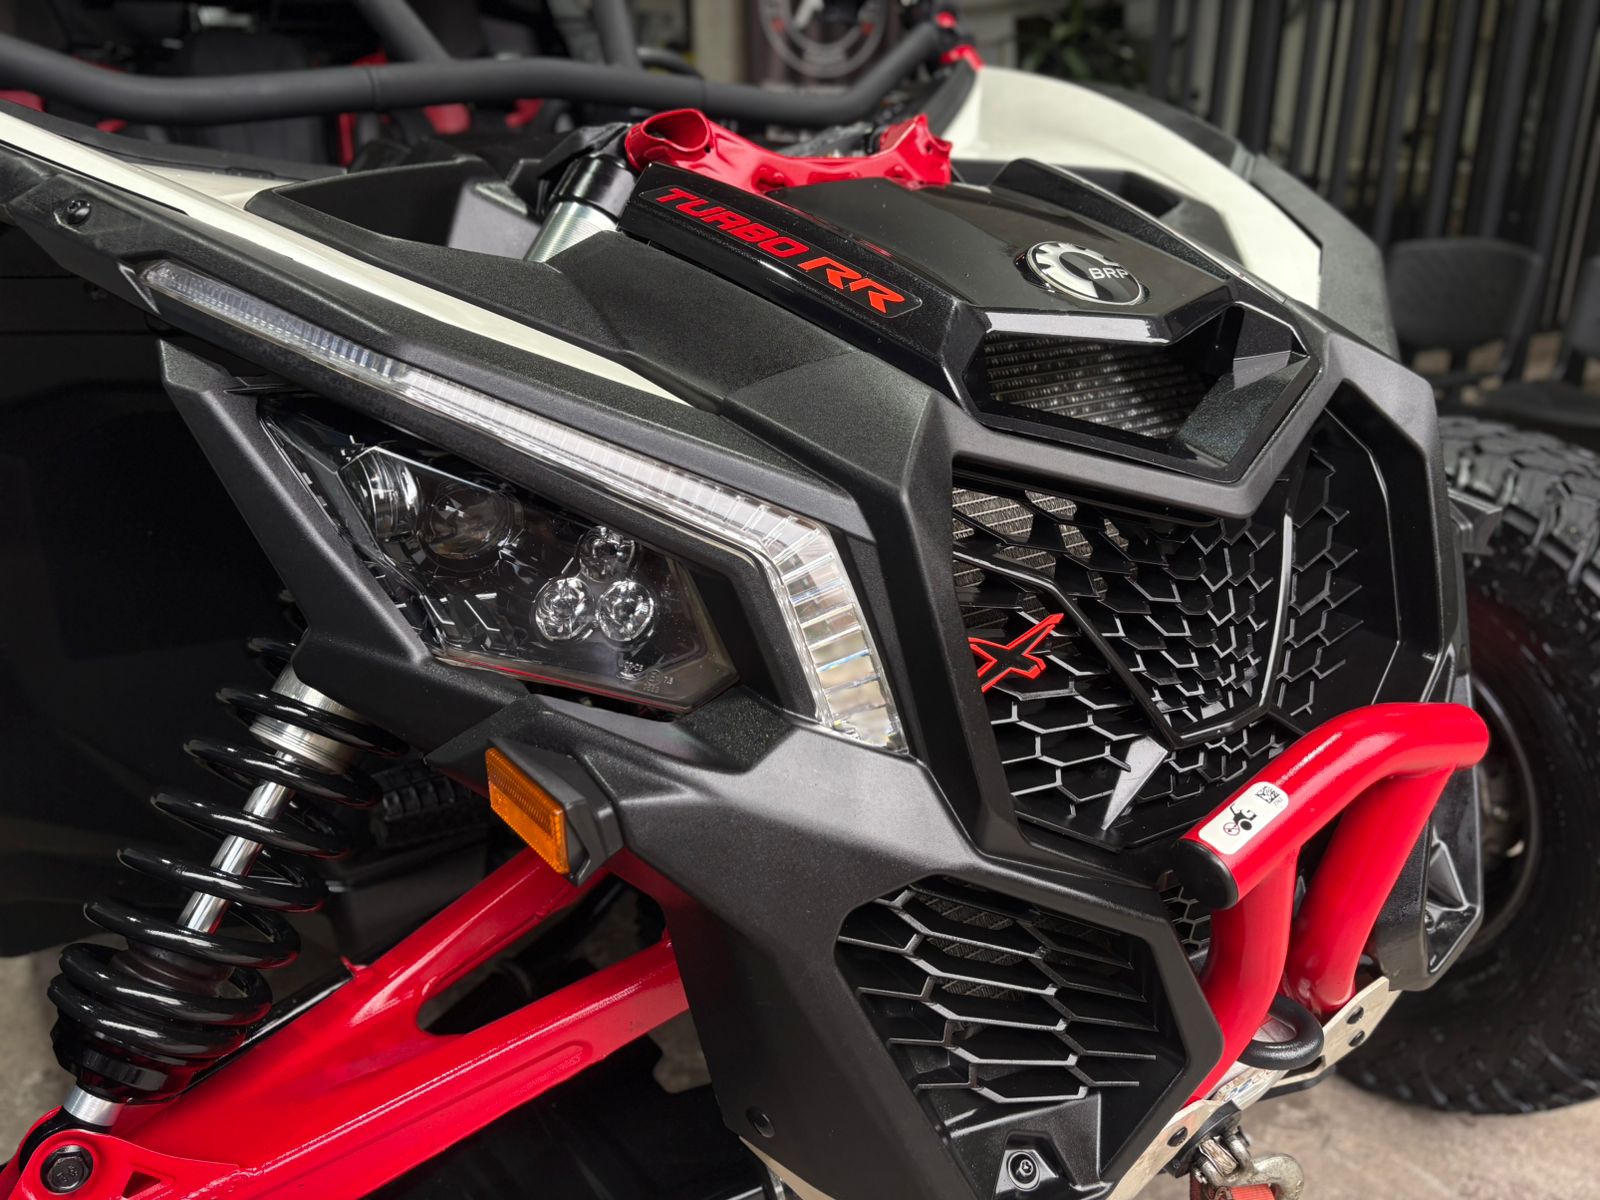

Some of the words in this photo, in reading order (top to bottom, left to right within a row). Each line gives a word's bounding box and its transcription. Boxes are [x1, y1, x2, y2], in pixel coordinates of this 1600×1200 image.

[656, 188, 810, 258] TURBO
[797, 256, 905, 314] RR
[1088, 267, 1128, 279] BRP
